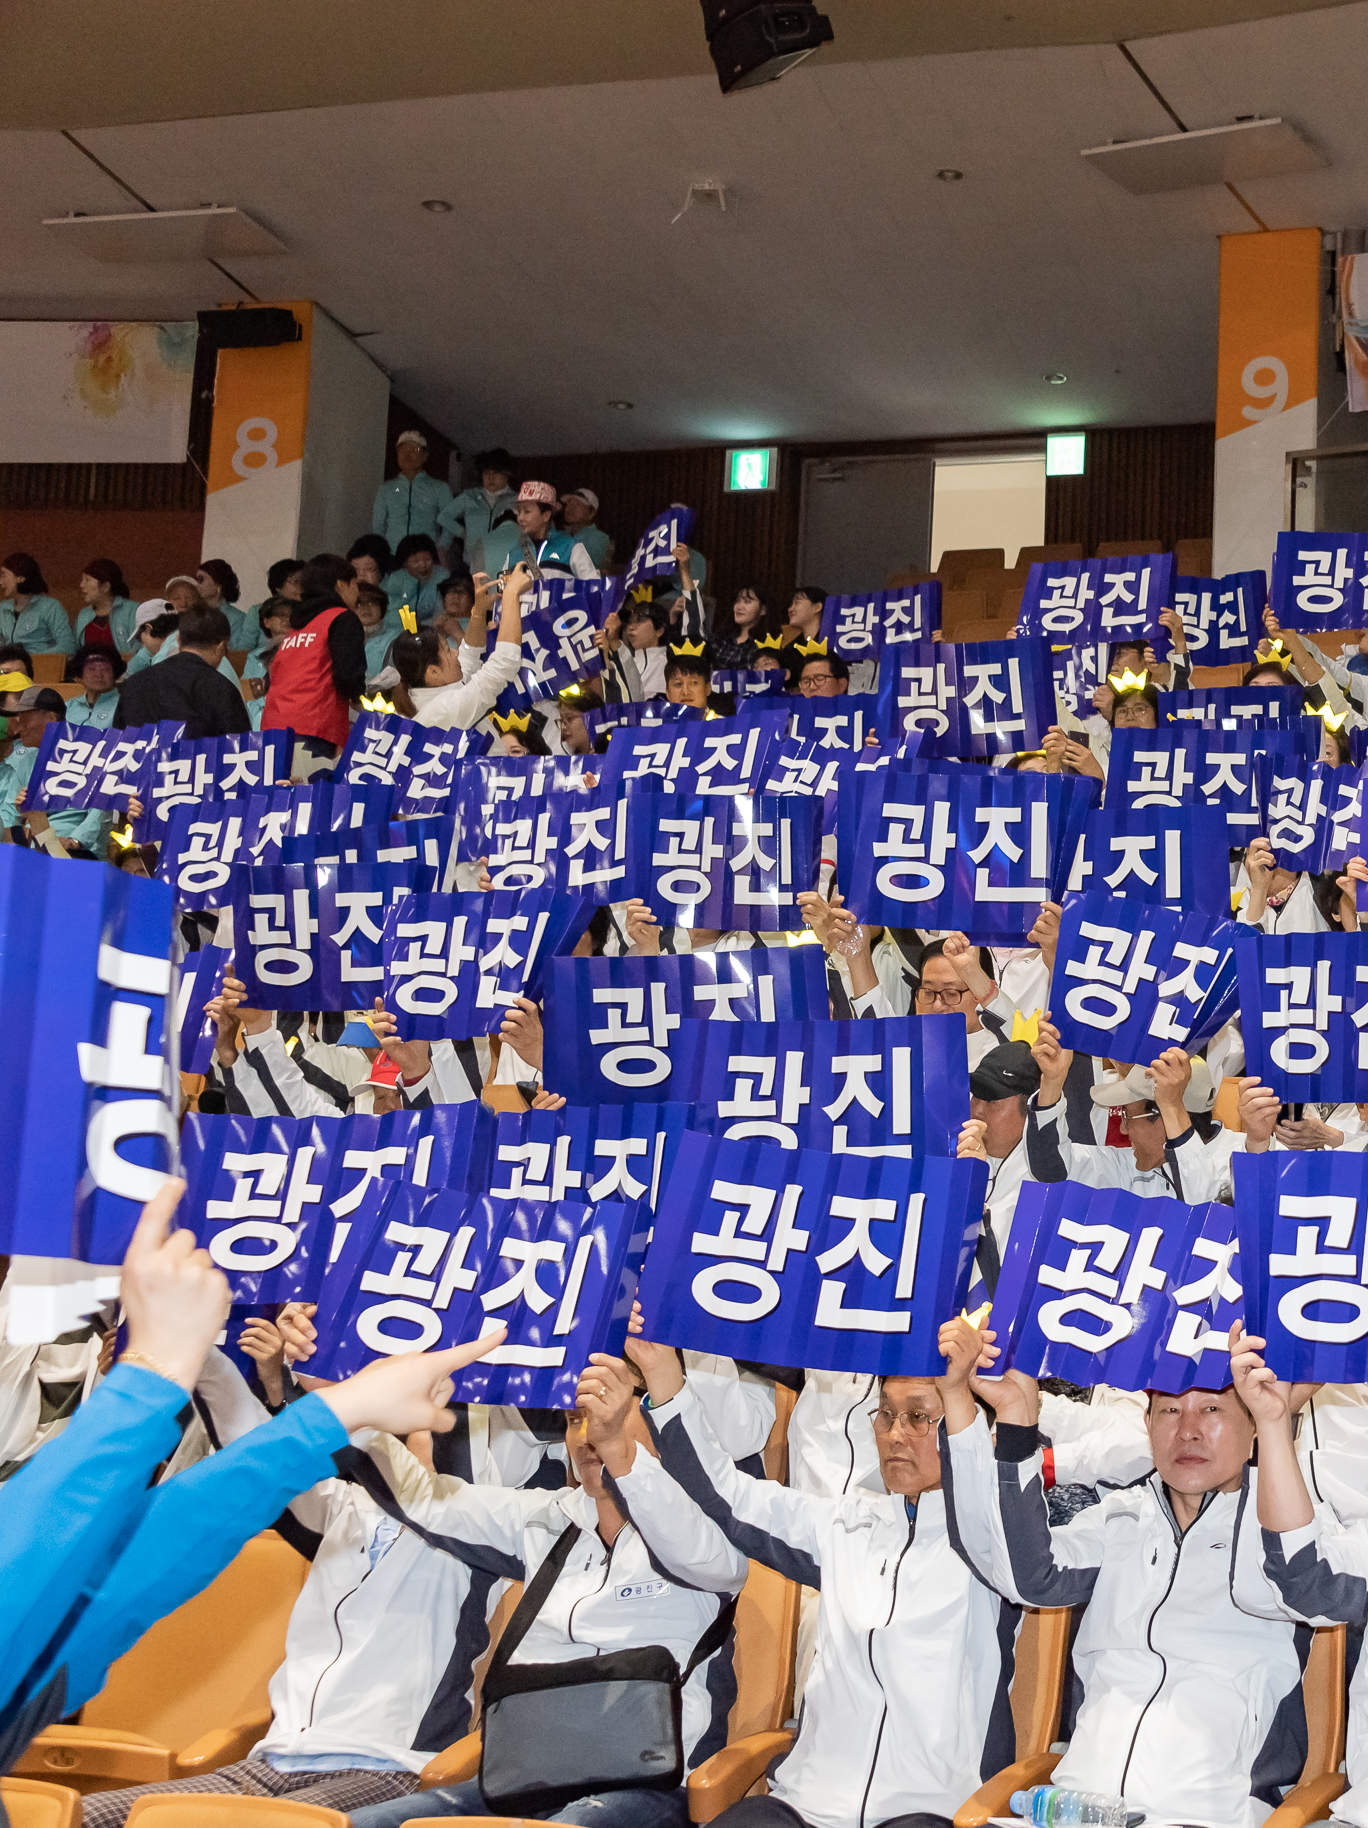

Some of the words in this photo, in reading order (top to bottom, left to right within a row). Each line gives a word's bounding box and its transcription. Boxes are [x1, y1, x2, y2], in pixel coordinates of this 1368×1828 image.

[1241, 356, 1289, 422] 9
[231, 417, 278, 479] 8
[835, 593, 923, 650] 광진
[1039, 567, 1152, 631] 광진
[1173, 586, 1250, 651] 광진
[282, 633, 316, 651] TAFF
[897, 657, 1027, 738] 광진
[349, 727, 468, 800] 광진
[488, 797, 629, 890] 광진
[652, 816, 794, 906] 광진
[872, 800, 1051, 902] 광진
[390, 911, 550, 1016] 광진
[1065, 920, 1234, 1043] 광진
[718, 1046, 912, 1158] 광진
[356, 1225, 594, 1367] 광진
[690, 1179, 926, 1333] 광진
